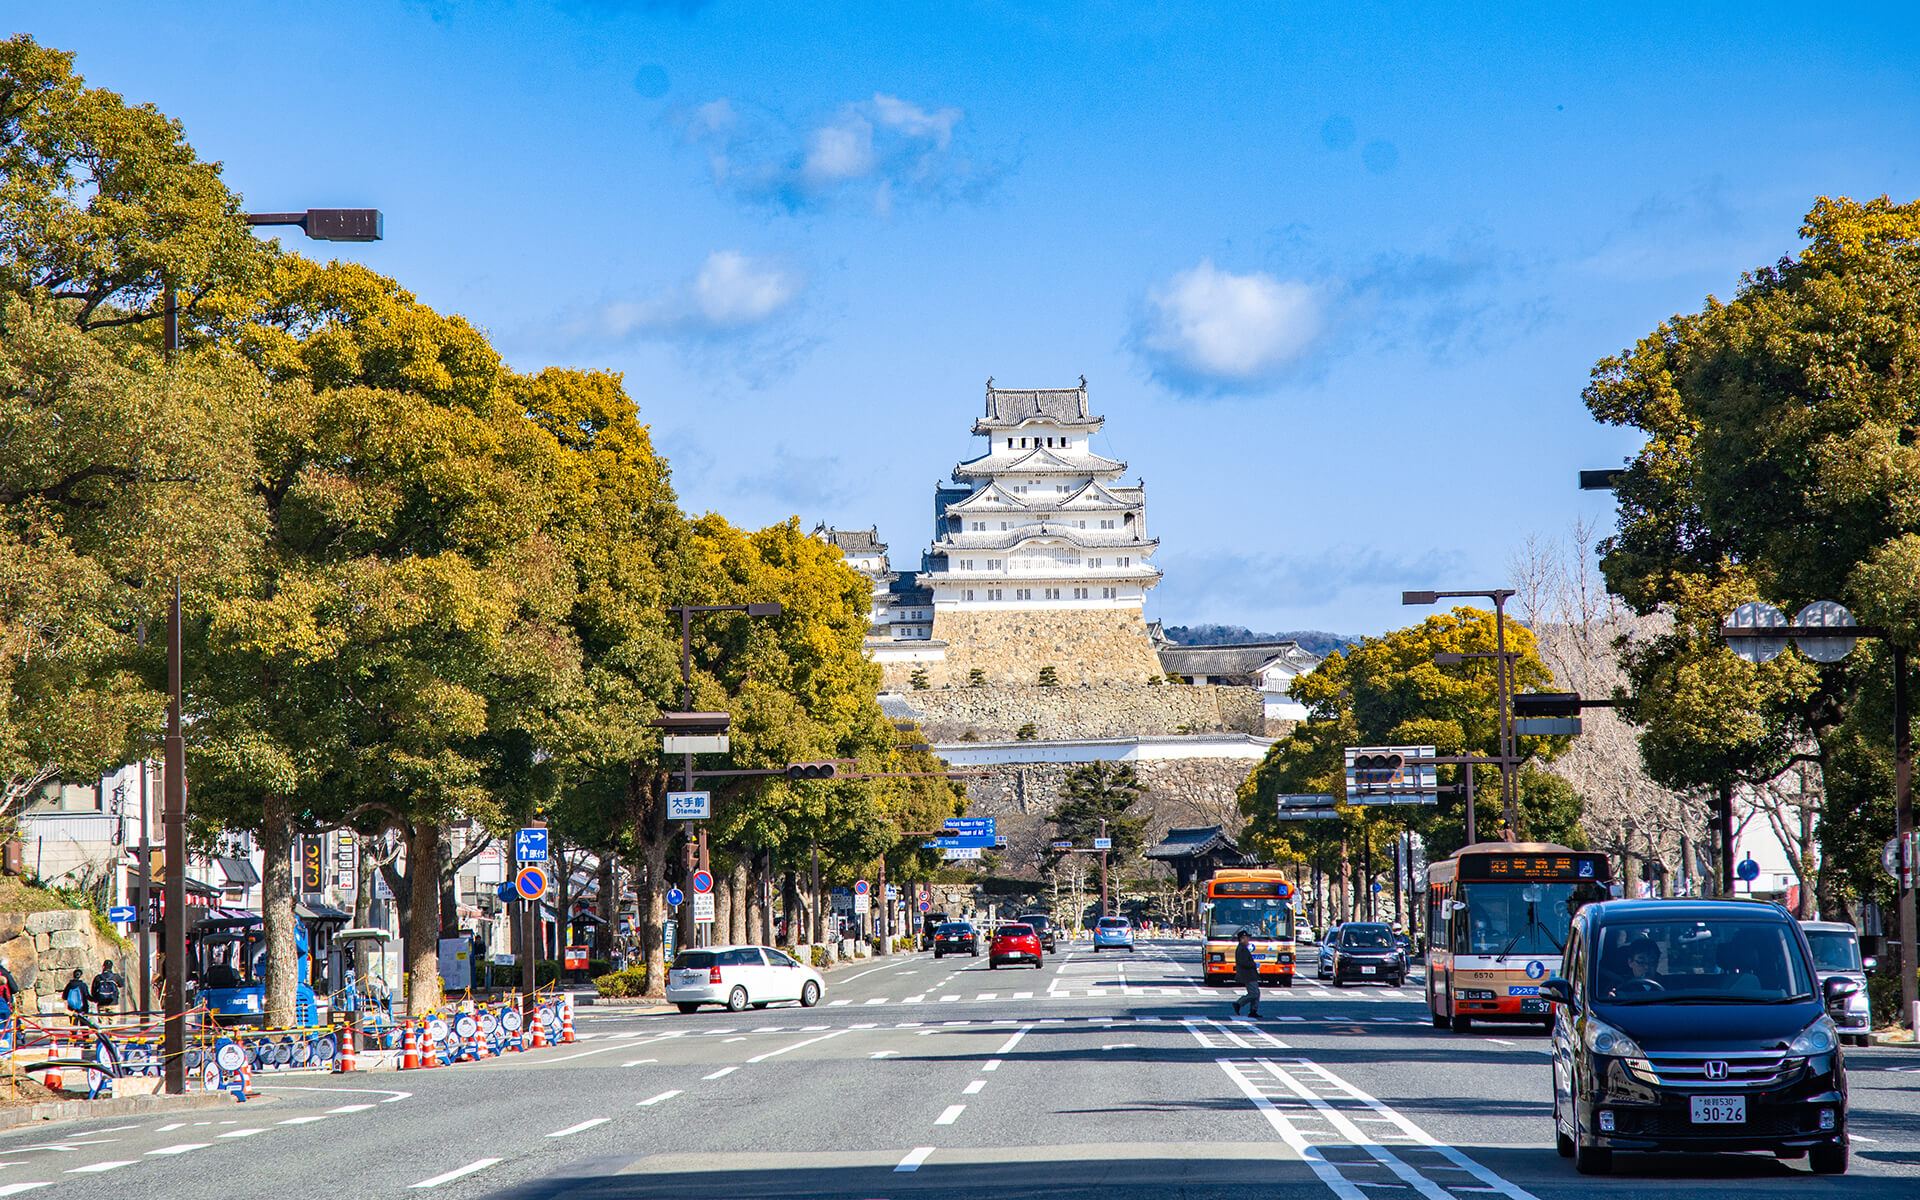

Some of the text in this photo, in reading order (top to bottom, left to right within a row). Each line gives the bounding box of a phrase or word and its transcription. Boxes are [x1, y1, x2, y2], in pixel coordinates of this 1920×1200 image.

[672, 797, 705, 808] 大手前
[529, 849, 546, 858] 原付
